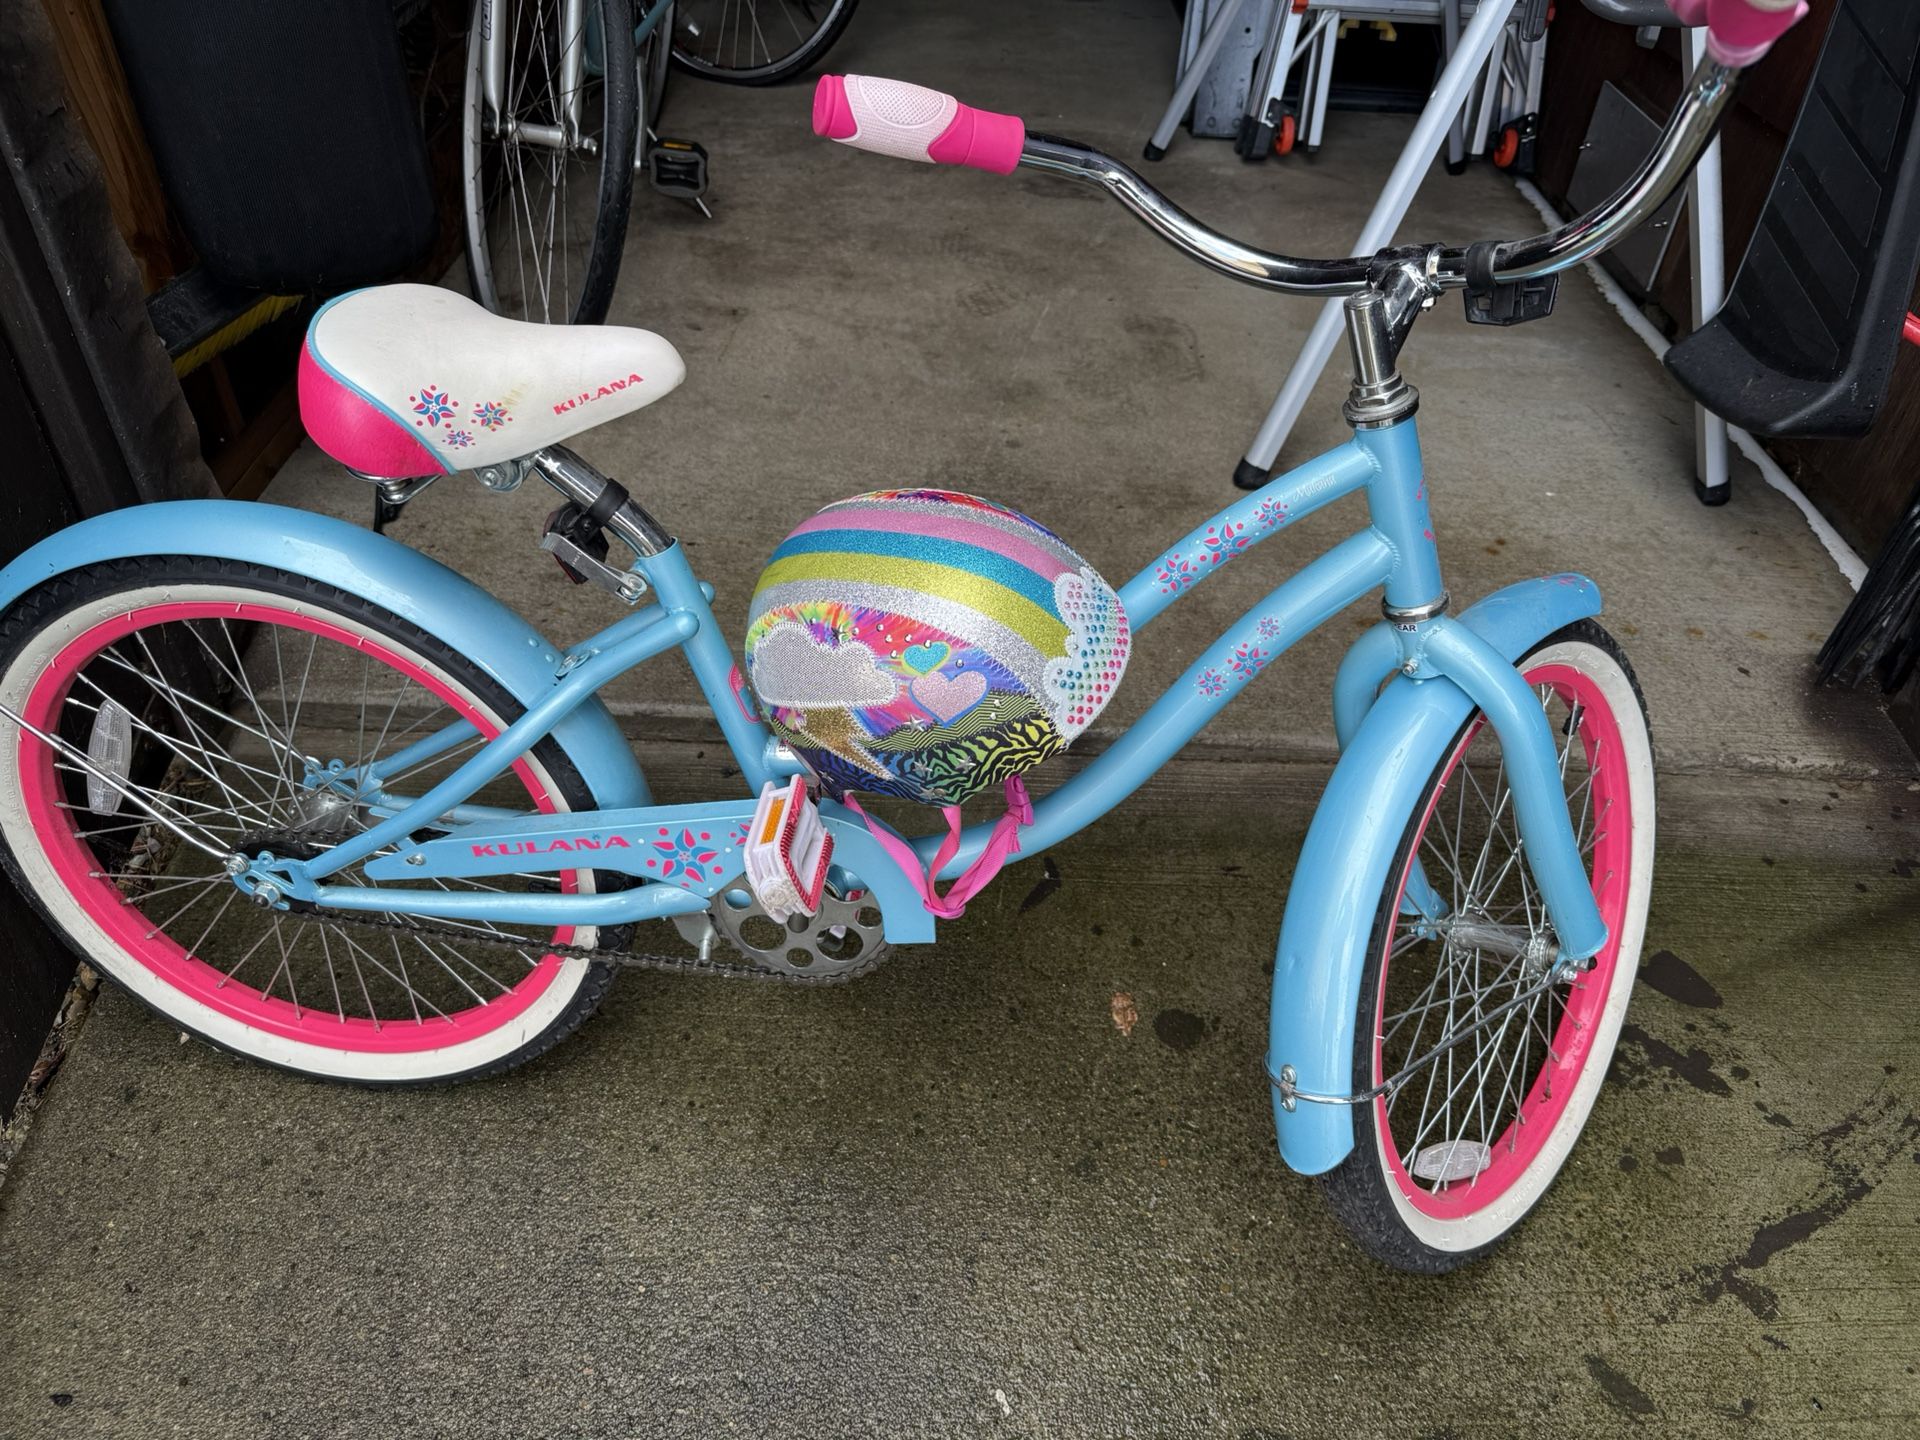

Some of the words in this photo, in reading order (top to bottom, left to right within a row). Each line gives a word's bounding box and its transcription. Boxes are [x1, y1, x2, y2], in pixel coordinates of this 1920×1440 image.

[553, 374, 644, 415] KULANA
[1394, 623, 1417, 632] EAR
[471, 835, 631, 858] KULANA
